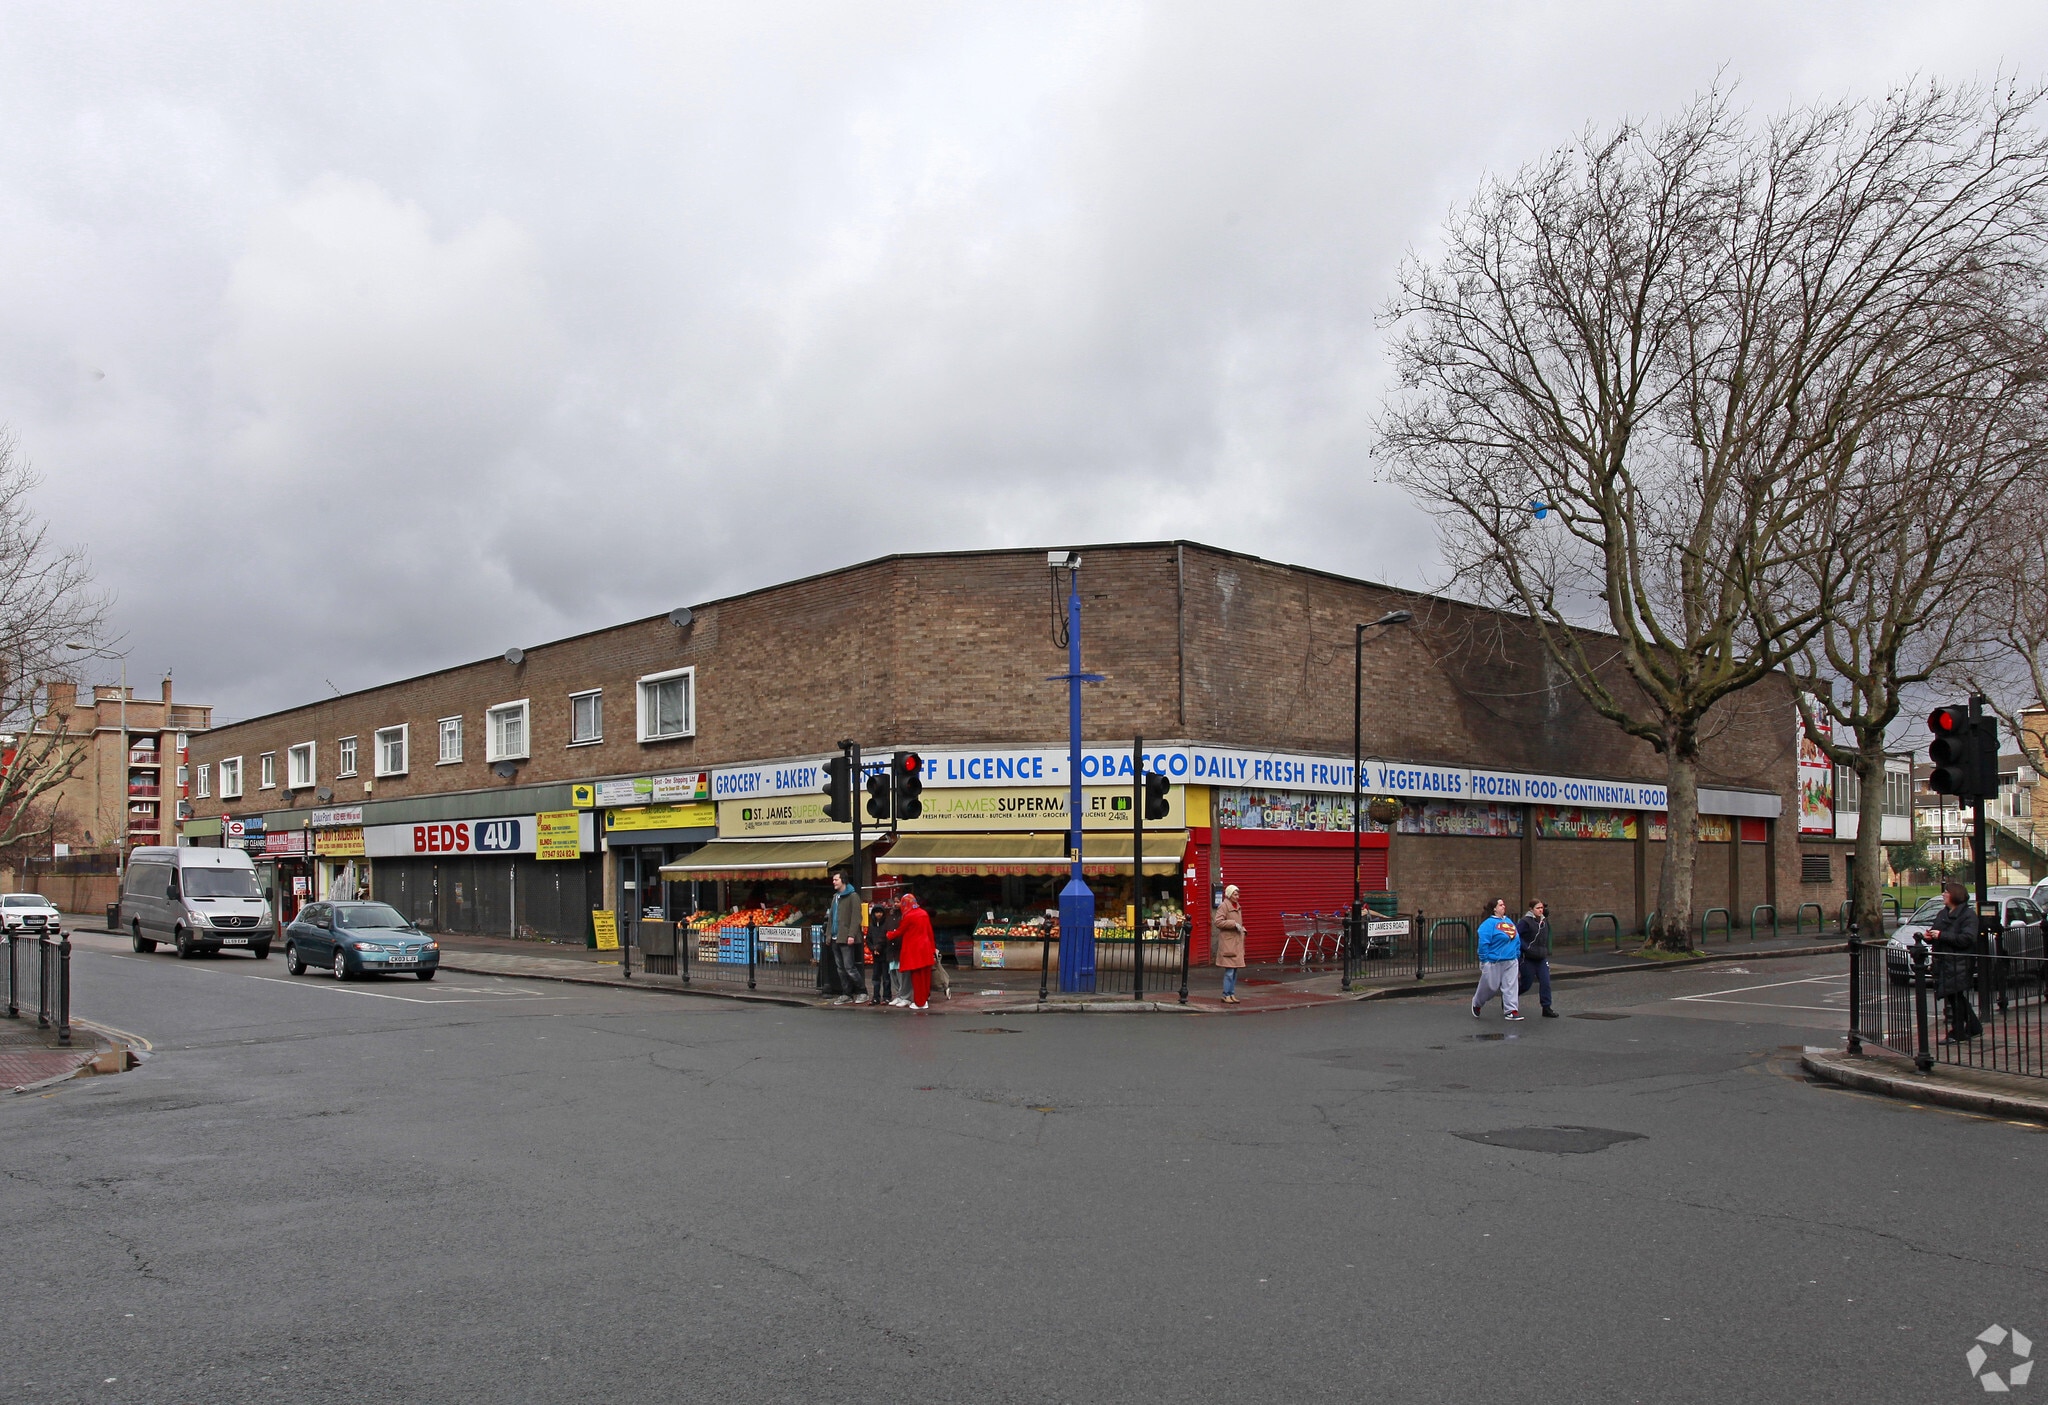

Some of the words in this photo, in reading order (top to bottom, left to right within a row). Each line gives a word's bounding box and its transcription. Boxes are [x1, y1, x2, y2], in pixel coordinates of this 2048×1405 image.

[947, 757, 1042, 780] LICENCE
[1067, 754, 1188, 778] OBACCO
[673, 776, 688, 784] Shipping
[716, 772, 761, 794] GROCERY
[776, 767, 817, 790] BAKERY
[1194, 755, 1248, 779] DAILY
[1254, 759, 1305, 783] FRESH
[1311, 763, 1354, 786] FRUIT
[1361, 768, 1370, 787] &
[1378, 769, 1461, 793] VEGETABLES
[1472, 775, 1520, 796] FROZEN
[1639, 789, 1668, 807] FOOD
[923, 799, 941, 813] ST.
[947, 797, 996, 812] JAMES
[998, 797, 1106, 811] SUPERMET
[753, 808, 763, 820] ST.
[766, 806, 792, 819] JAMES
[1263, 810, 1290, 823] OFF
[1296, 811, 1353, 825] LICENCE
[1435, 816, 1485, 829] GROCERY
[1559, 821, 1586, 832] FRUIT
[1587, 823, 1594, 832] &
[1596, 823, 1613, 833] VEG
[413, 823, 470, 853] BEDS
[483, 821, 512, 849] 4U
[542, 850, 555, 858] 07947
[935, 865, 977, 873] ENGLISH
[986, 865, 1029, 874] TURKISH
[1037, 865, 1071, 874] CYPRU
[1084, 866, 1116, 874] GREEK
[1393, 921, 1404, 929] ROAD
